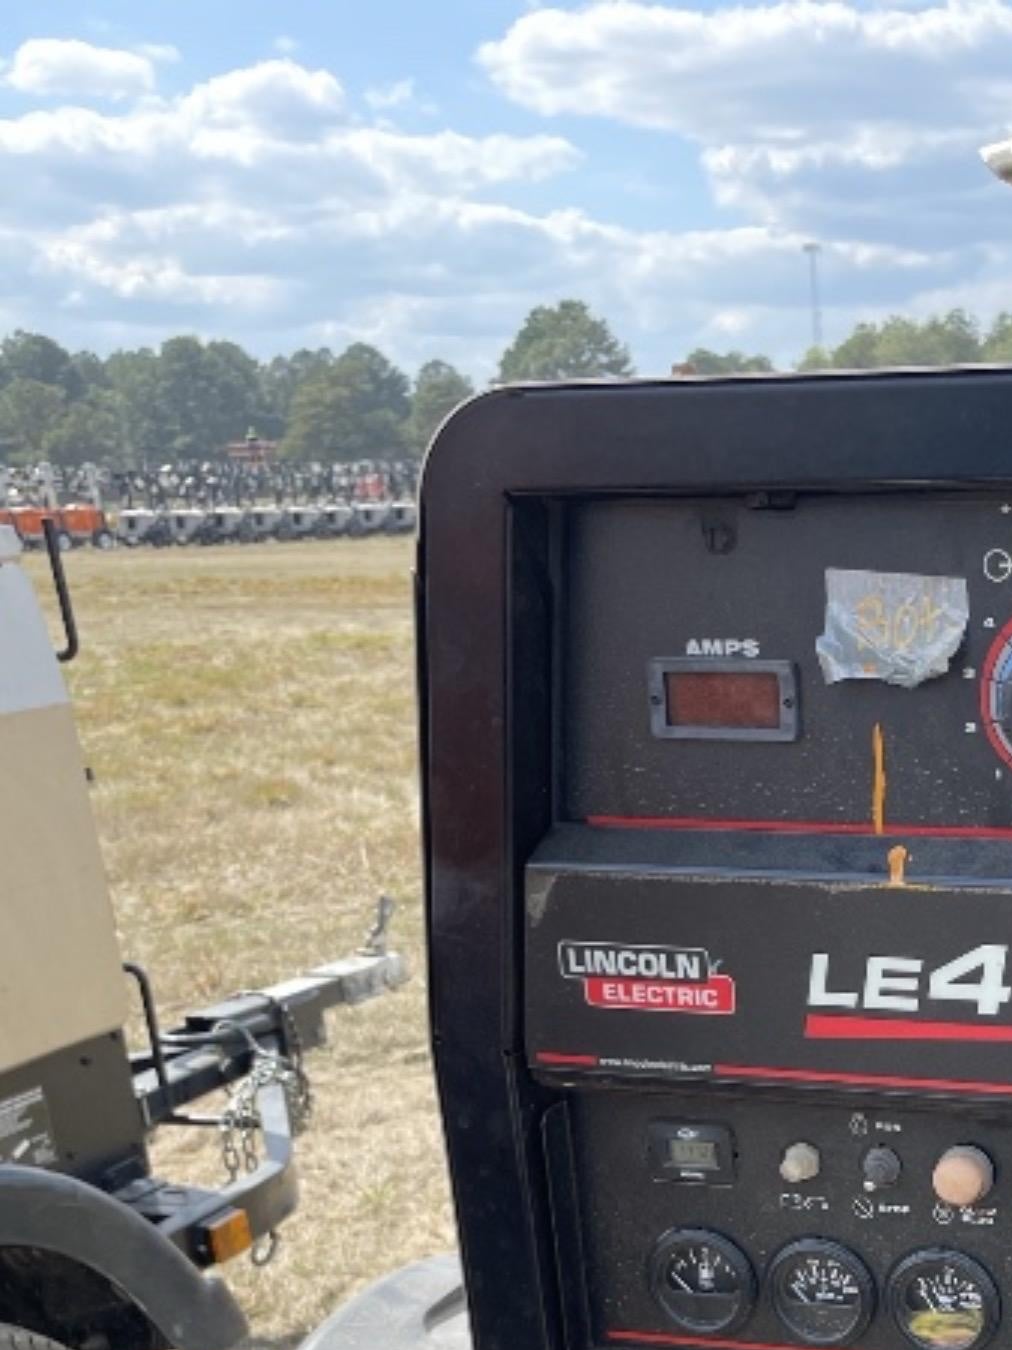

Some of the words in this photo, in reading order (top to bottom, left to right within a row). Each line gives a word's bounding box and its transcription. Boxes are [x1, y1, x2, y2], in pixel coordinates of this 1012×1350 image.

[983, 617, 995, 628] 4
[686, 639, 760, 657] AMPS
[995, 768, 1002, 780] 1
[567, 947, 700, 980] LINCOLN
[602, 983, 718, 1007] ELECTRIC
